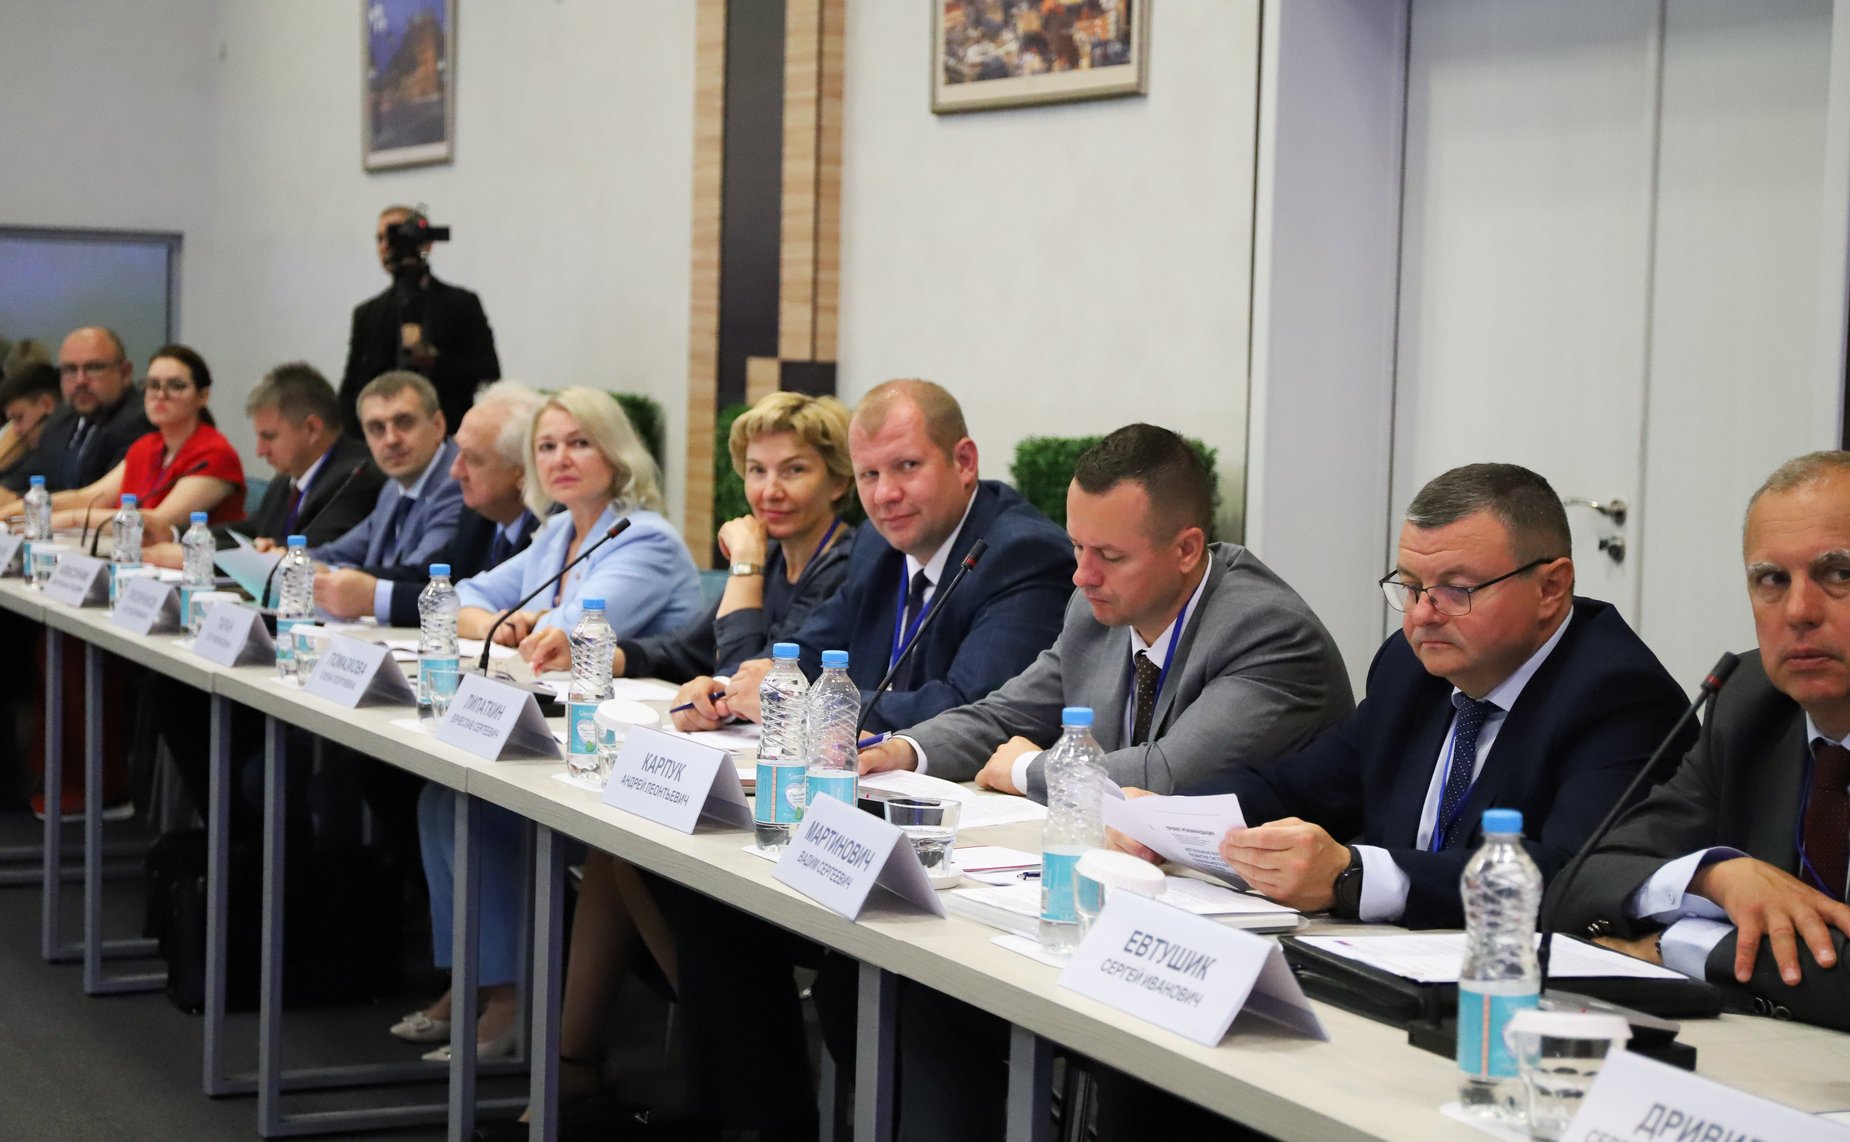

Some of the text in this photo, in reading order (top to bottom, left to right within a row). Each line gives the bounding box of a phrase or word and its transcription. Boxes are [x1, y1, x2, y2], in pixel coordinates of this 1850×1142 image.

[641, 752, 687, 782] КАРПУК
[620, 774, 690, 806] АНДРЕЙ ЛЕОНТЬЕВИЧ
[804, 820, 876, 872] МАРТИНОВИЧ
[797, 850, 854, 889] ВАДИМ СЕРГЕЕВИЧ
[1123, 929, 1217, 981] ЕВТУШИК
[1100, 958, 1204, 1008] СЕРГЕЙ ИВАНОВИЧ
